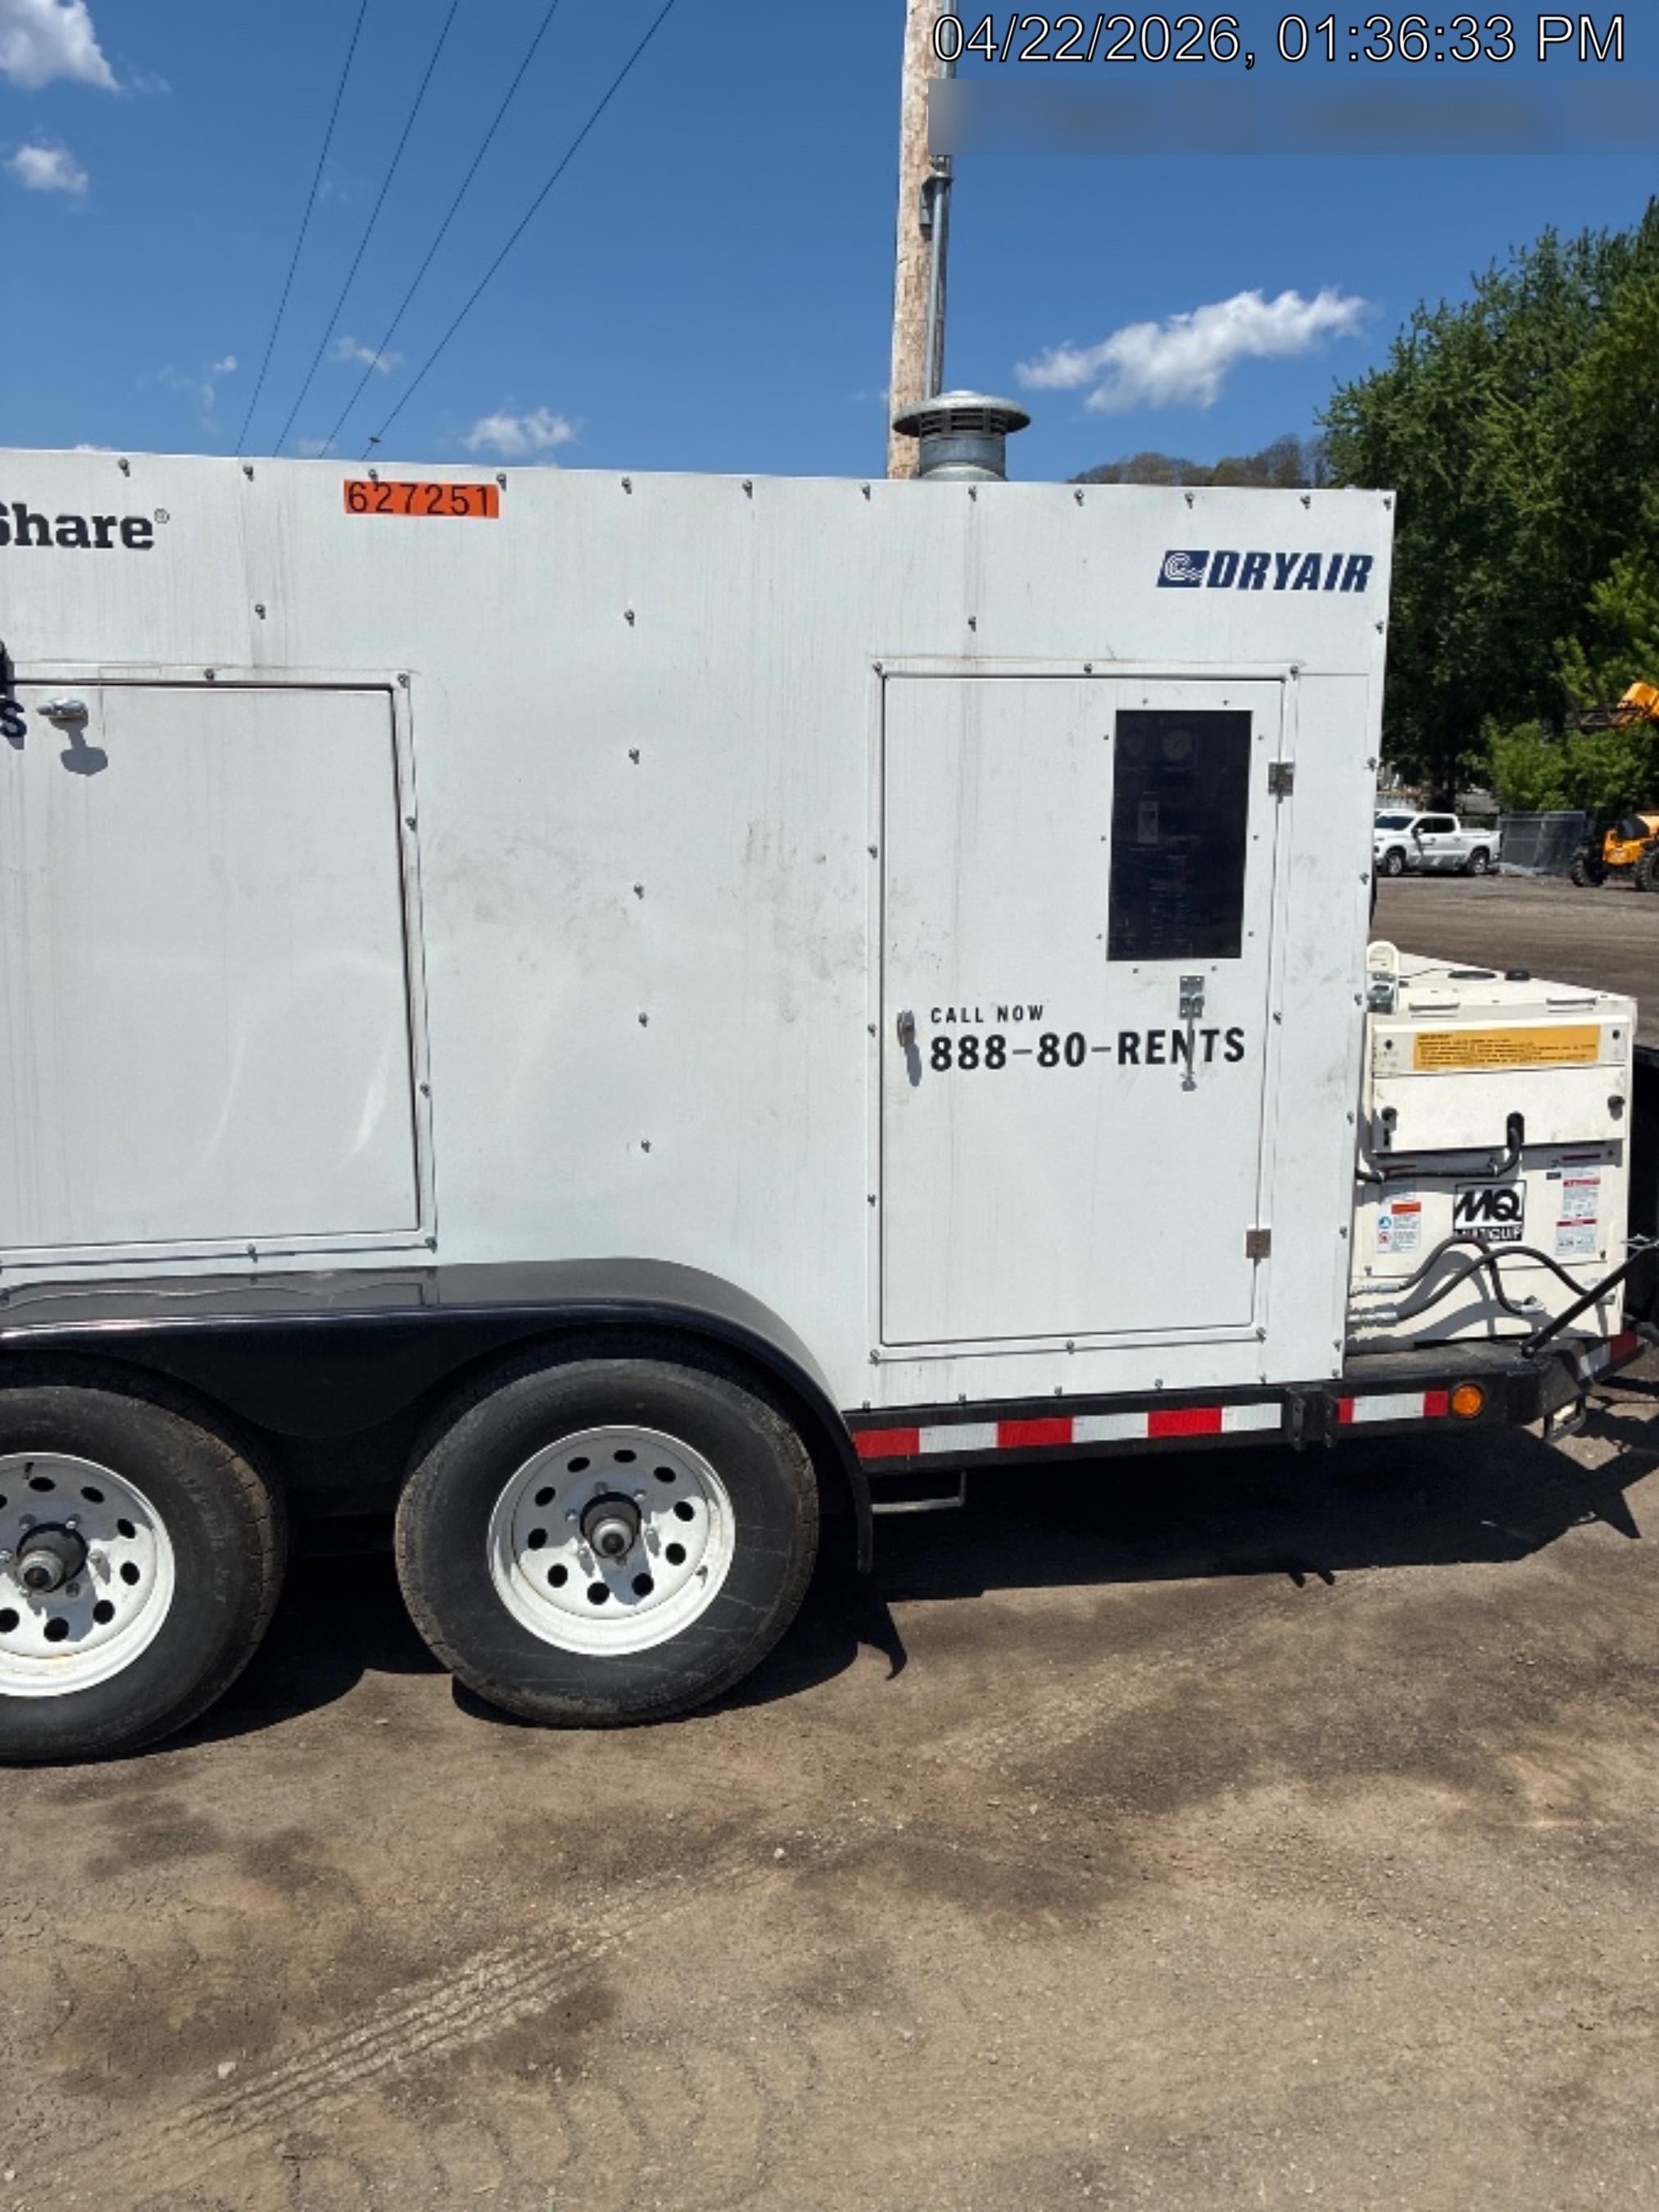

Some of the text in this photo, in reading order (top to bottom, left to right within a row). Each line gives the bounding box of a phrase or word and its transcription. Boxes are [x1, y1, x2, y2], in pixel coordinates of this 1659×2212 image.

[348, 481, 488, 516] 627251
[1206, 550, 1374, 593] DRYAIR
[931, 1004, 1044, 1023] CALL NOW
[931, 1027, 1245, 1072] 888-80-RENTS
[1454, 1189, 1523, 1222] MQ
